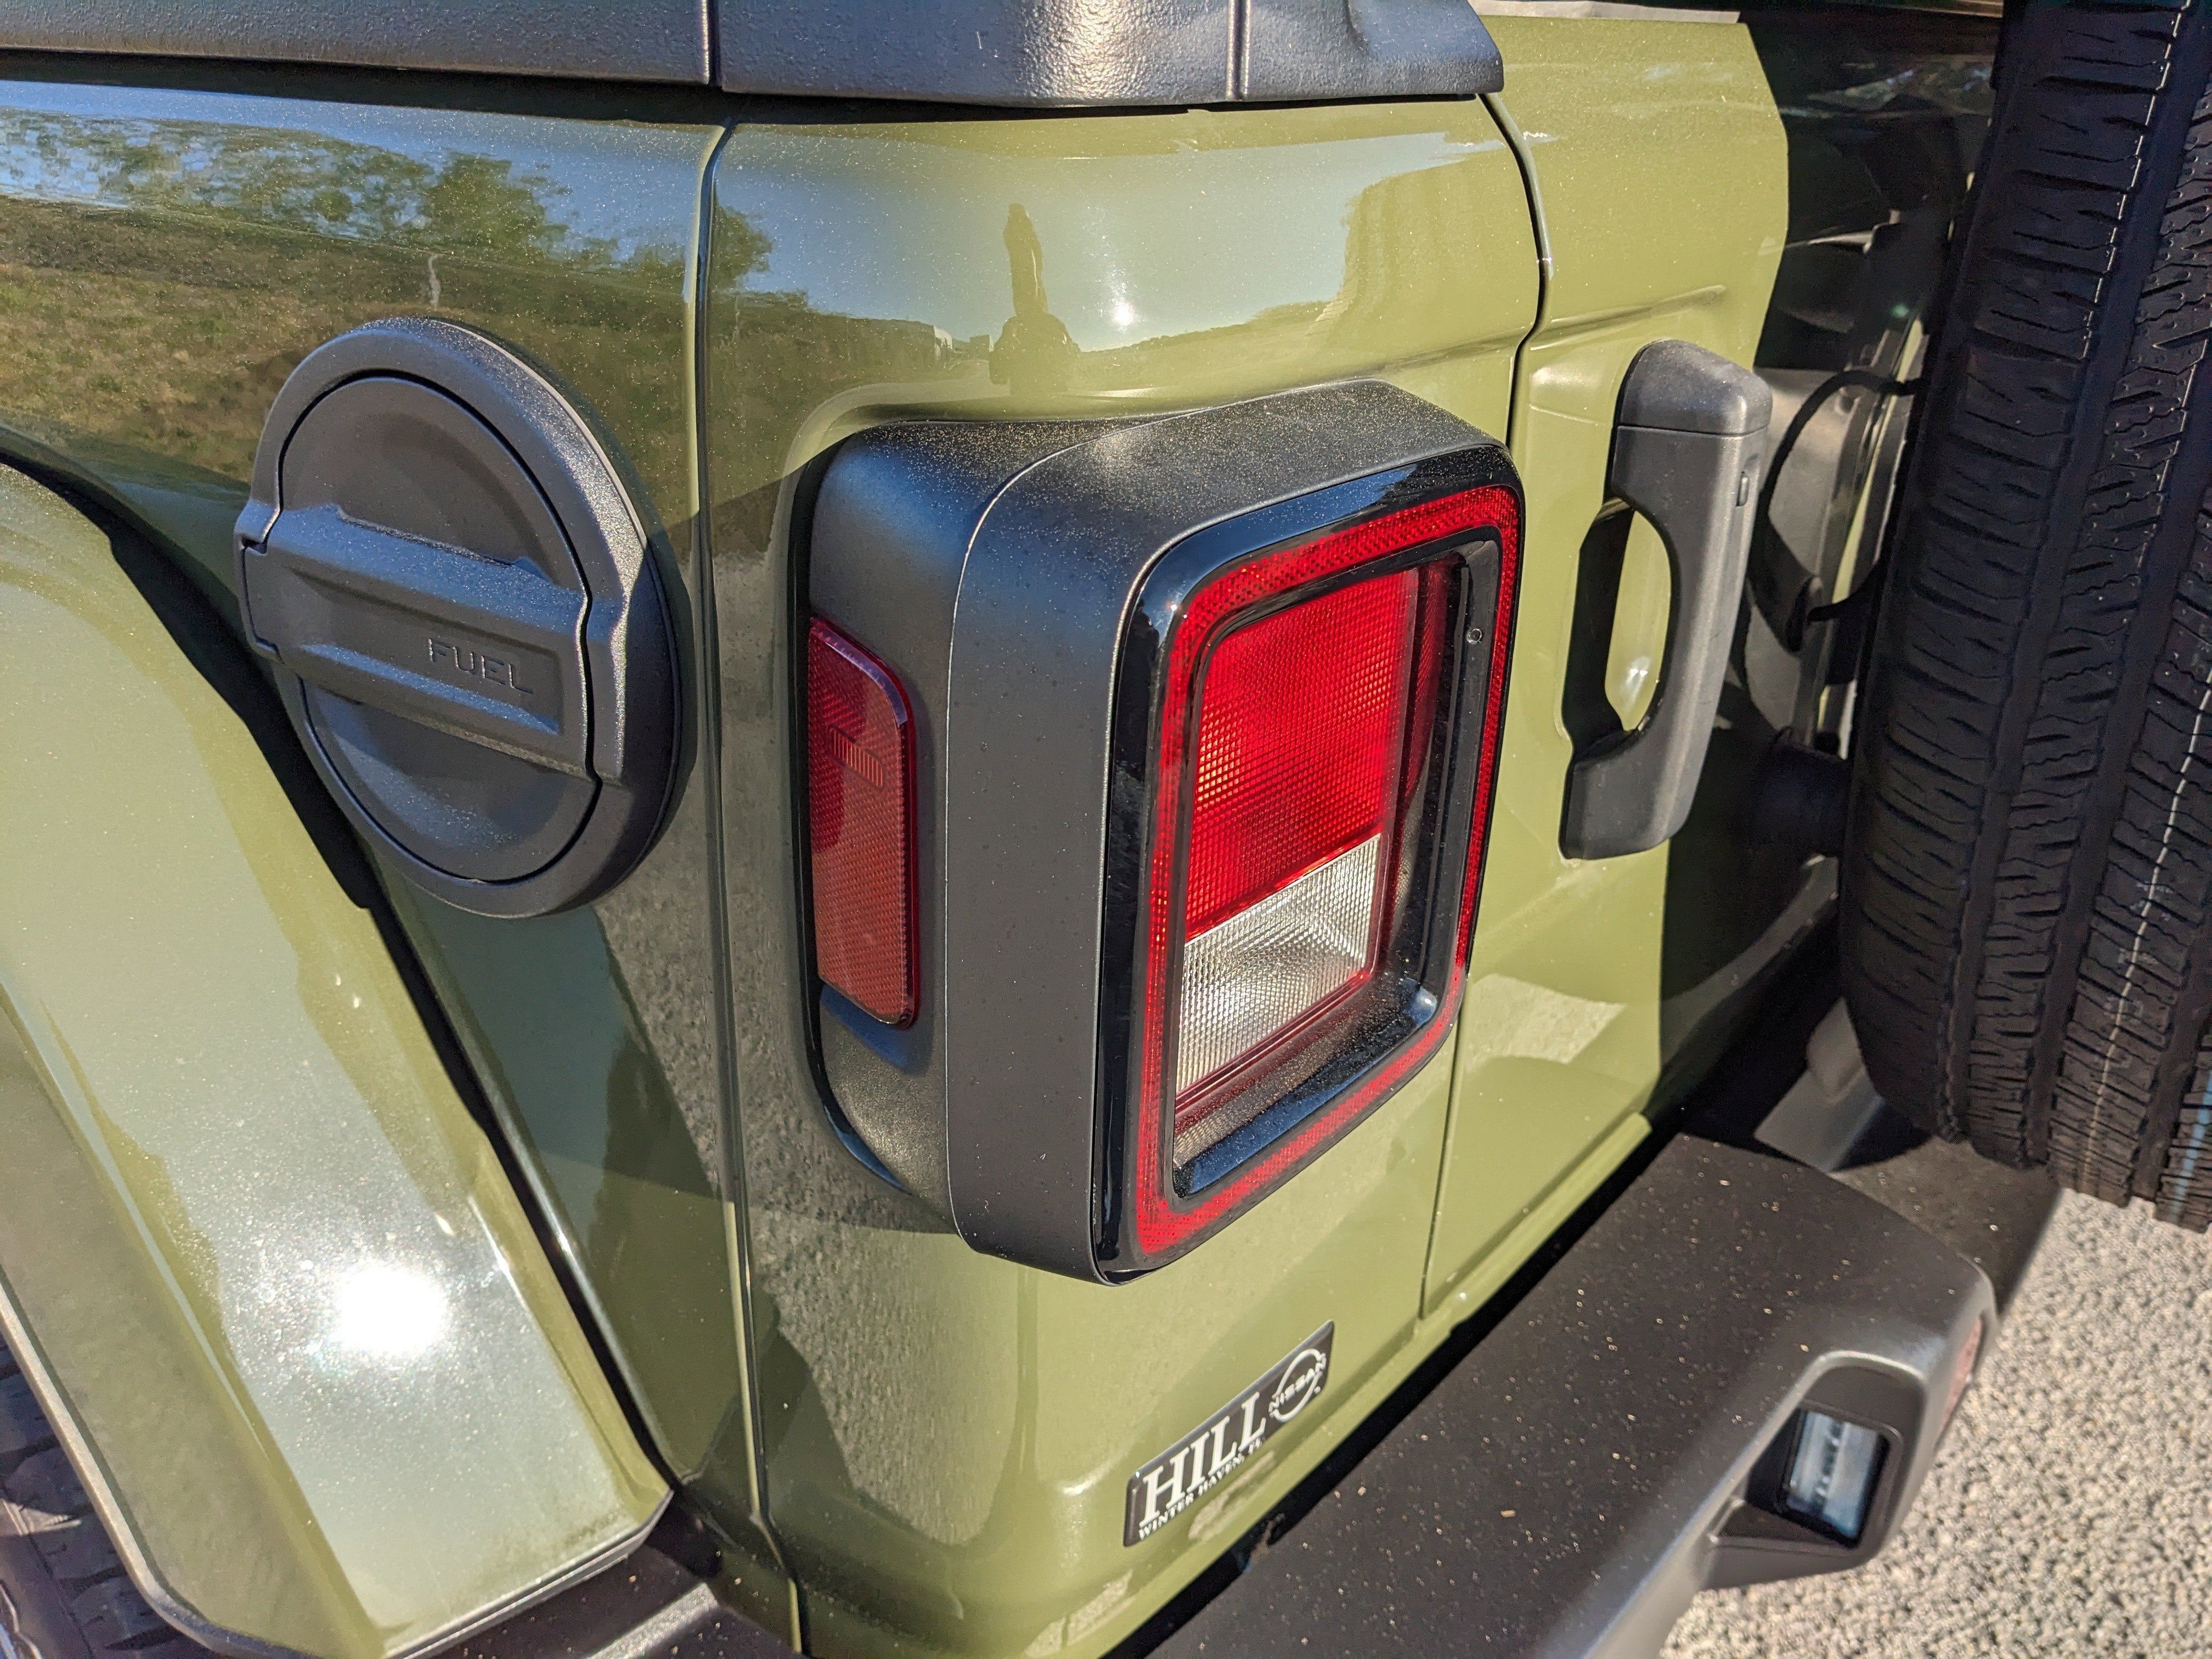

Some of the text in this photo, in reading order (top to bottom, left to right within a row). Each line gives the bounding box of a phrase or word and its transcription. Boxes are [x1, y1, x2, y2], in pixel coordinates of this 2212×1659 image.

[428, 637, 535, 695] FUEL
[1138, 1391, 1267, 1529] HILL
[1138, 1493, 1194, 1541] WINTER
